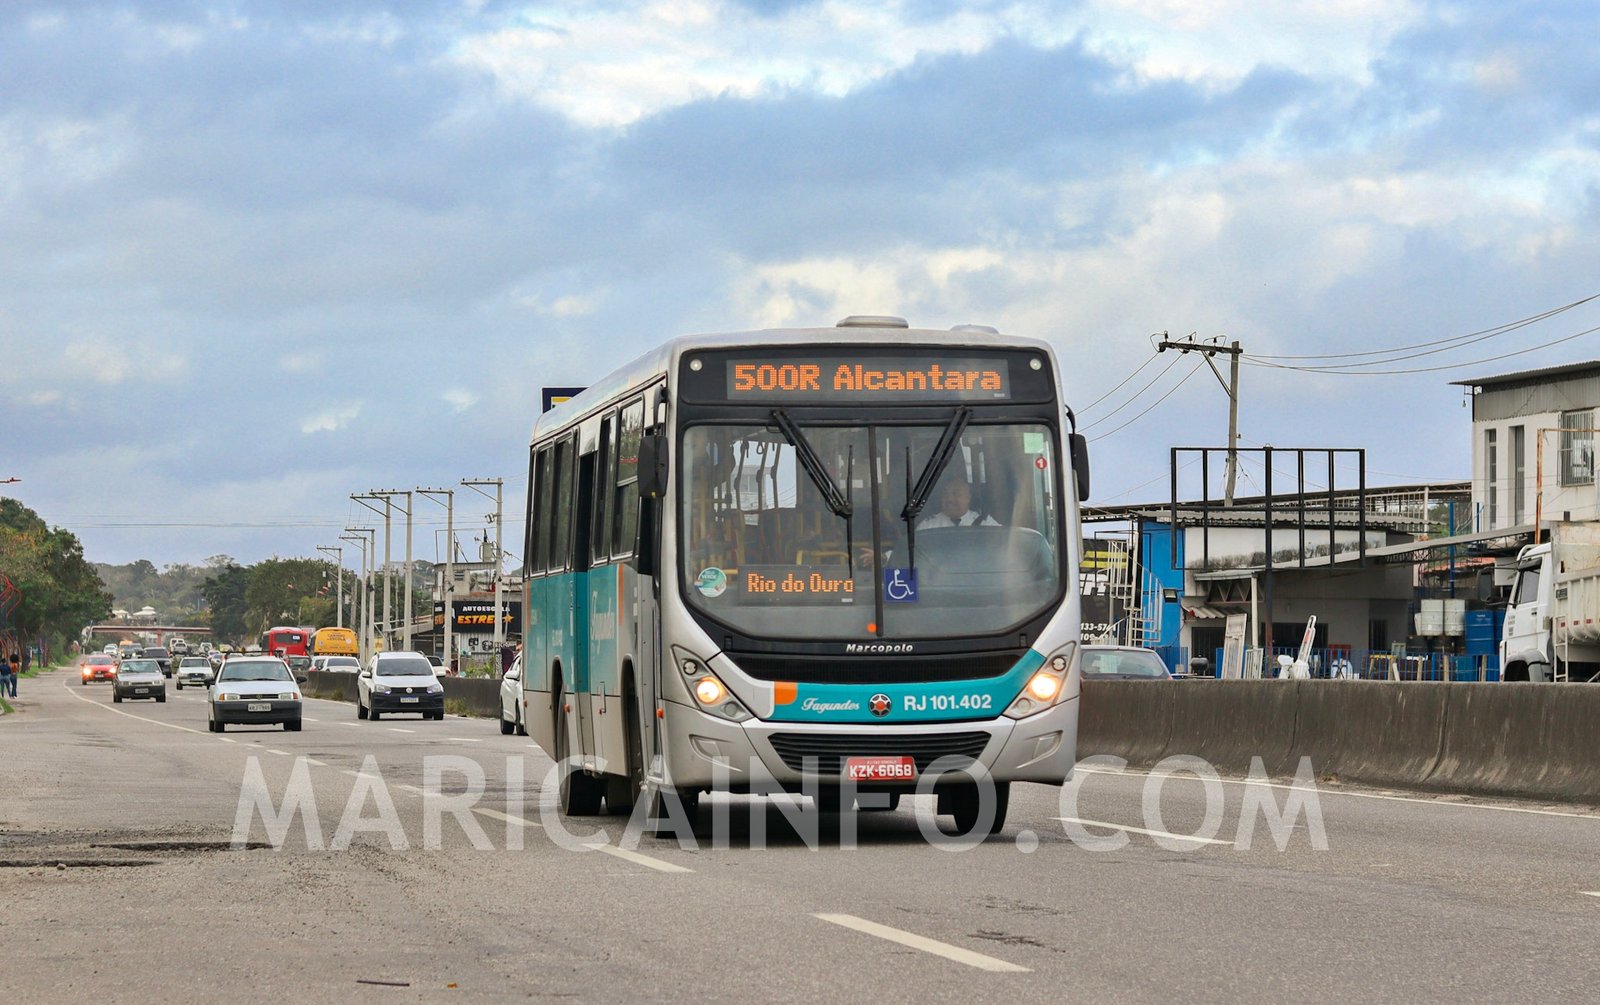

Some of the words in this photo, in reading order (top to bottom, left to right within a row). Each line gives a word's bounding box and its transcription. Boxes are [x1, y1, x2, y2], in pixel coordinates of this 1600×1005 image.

[735, 364, 820, 391] 500R
[833, 364, 1001, 391] Alcantara
[747, 573, 777, 593] Rio
[781, 573, 805, 593] do
[846, 643, 913, 653] Marcopolo
[801, 697, 860, 714] Fagundes
[904, 695, 926, 711] RJ
[930, 694, 992, 710] 101.402
